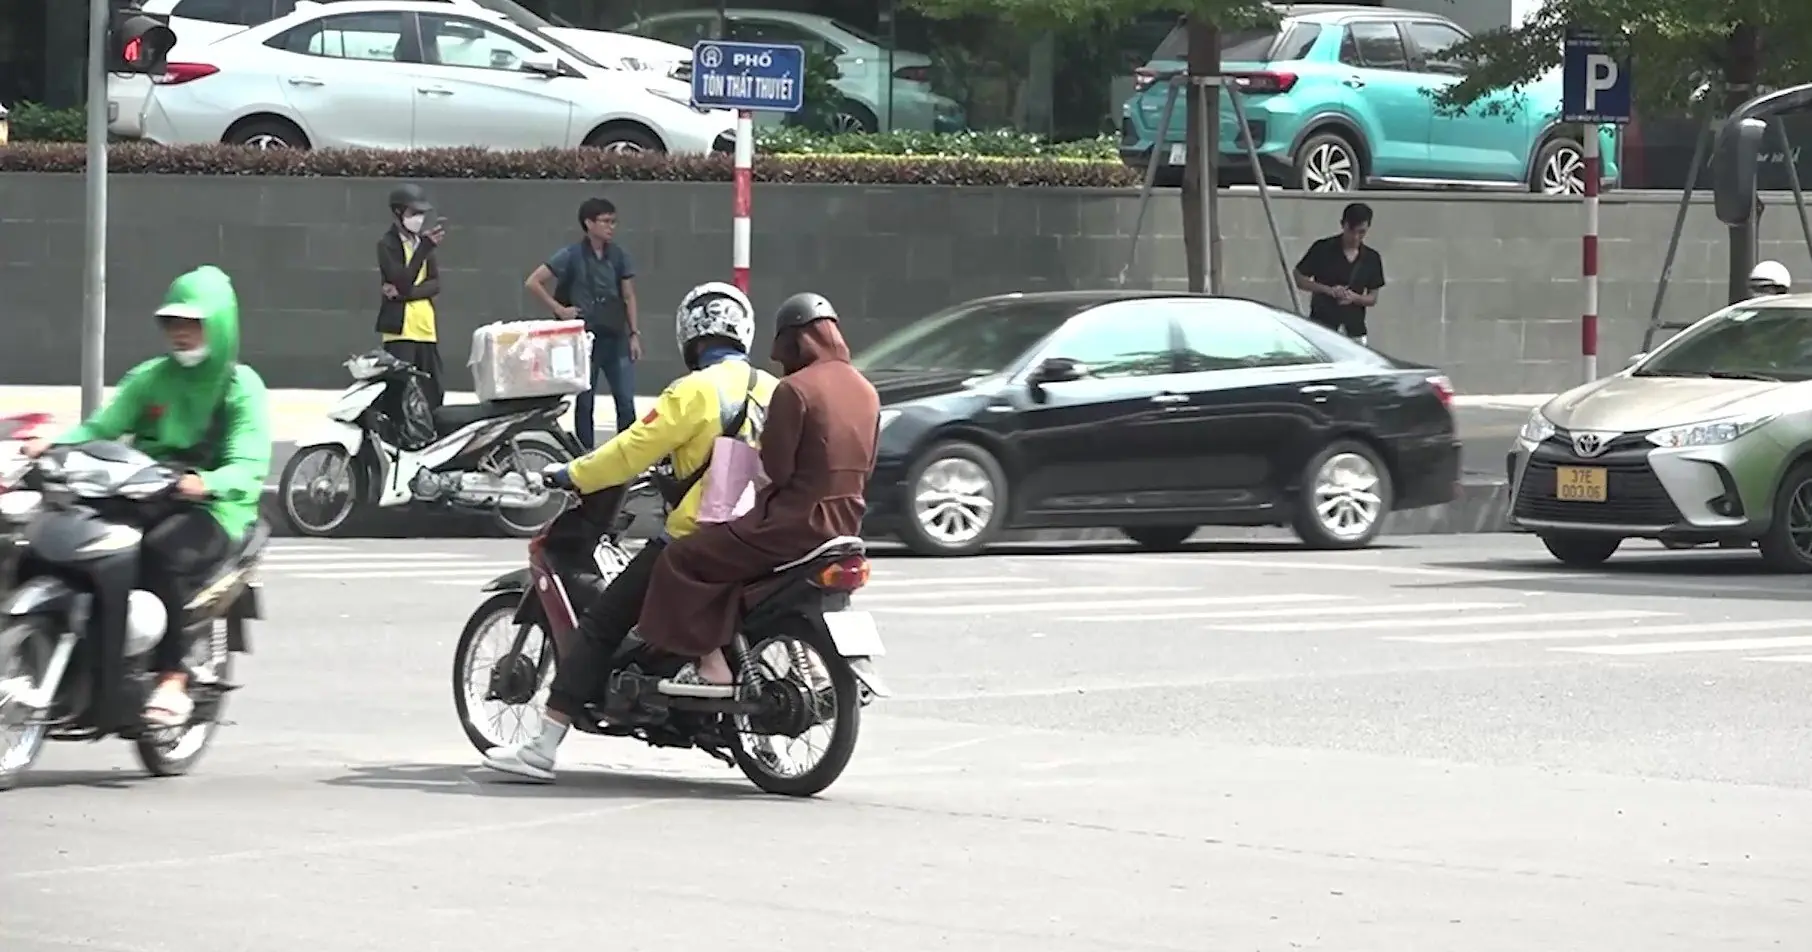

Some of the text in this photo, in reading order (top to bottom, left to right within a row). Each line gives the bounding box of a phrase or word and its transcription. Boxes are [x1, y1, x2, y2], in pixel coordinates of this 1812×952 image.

[733, 49, 773, 68] PHỐ
[702, 68, 794, 100] TÔN THẤT THUYẾT
[1585, 53, 1619, 111] P
[1571, 469, 1593, 483] 37E
